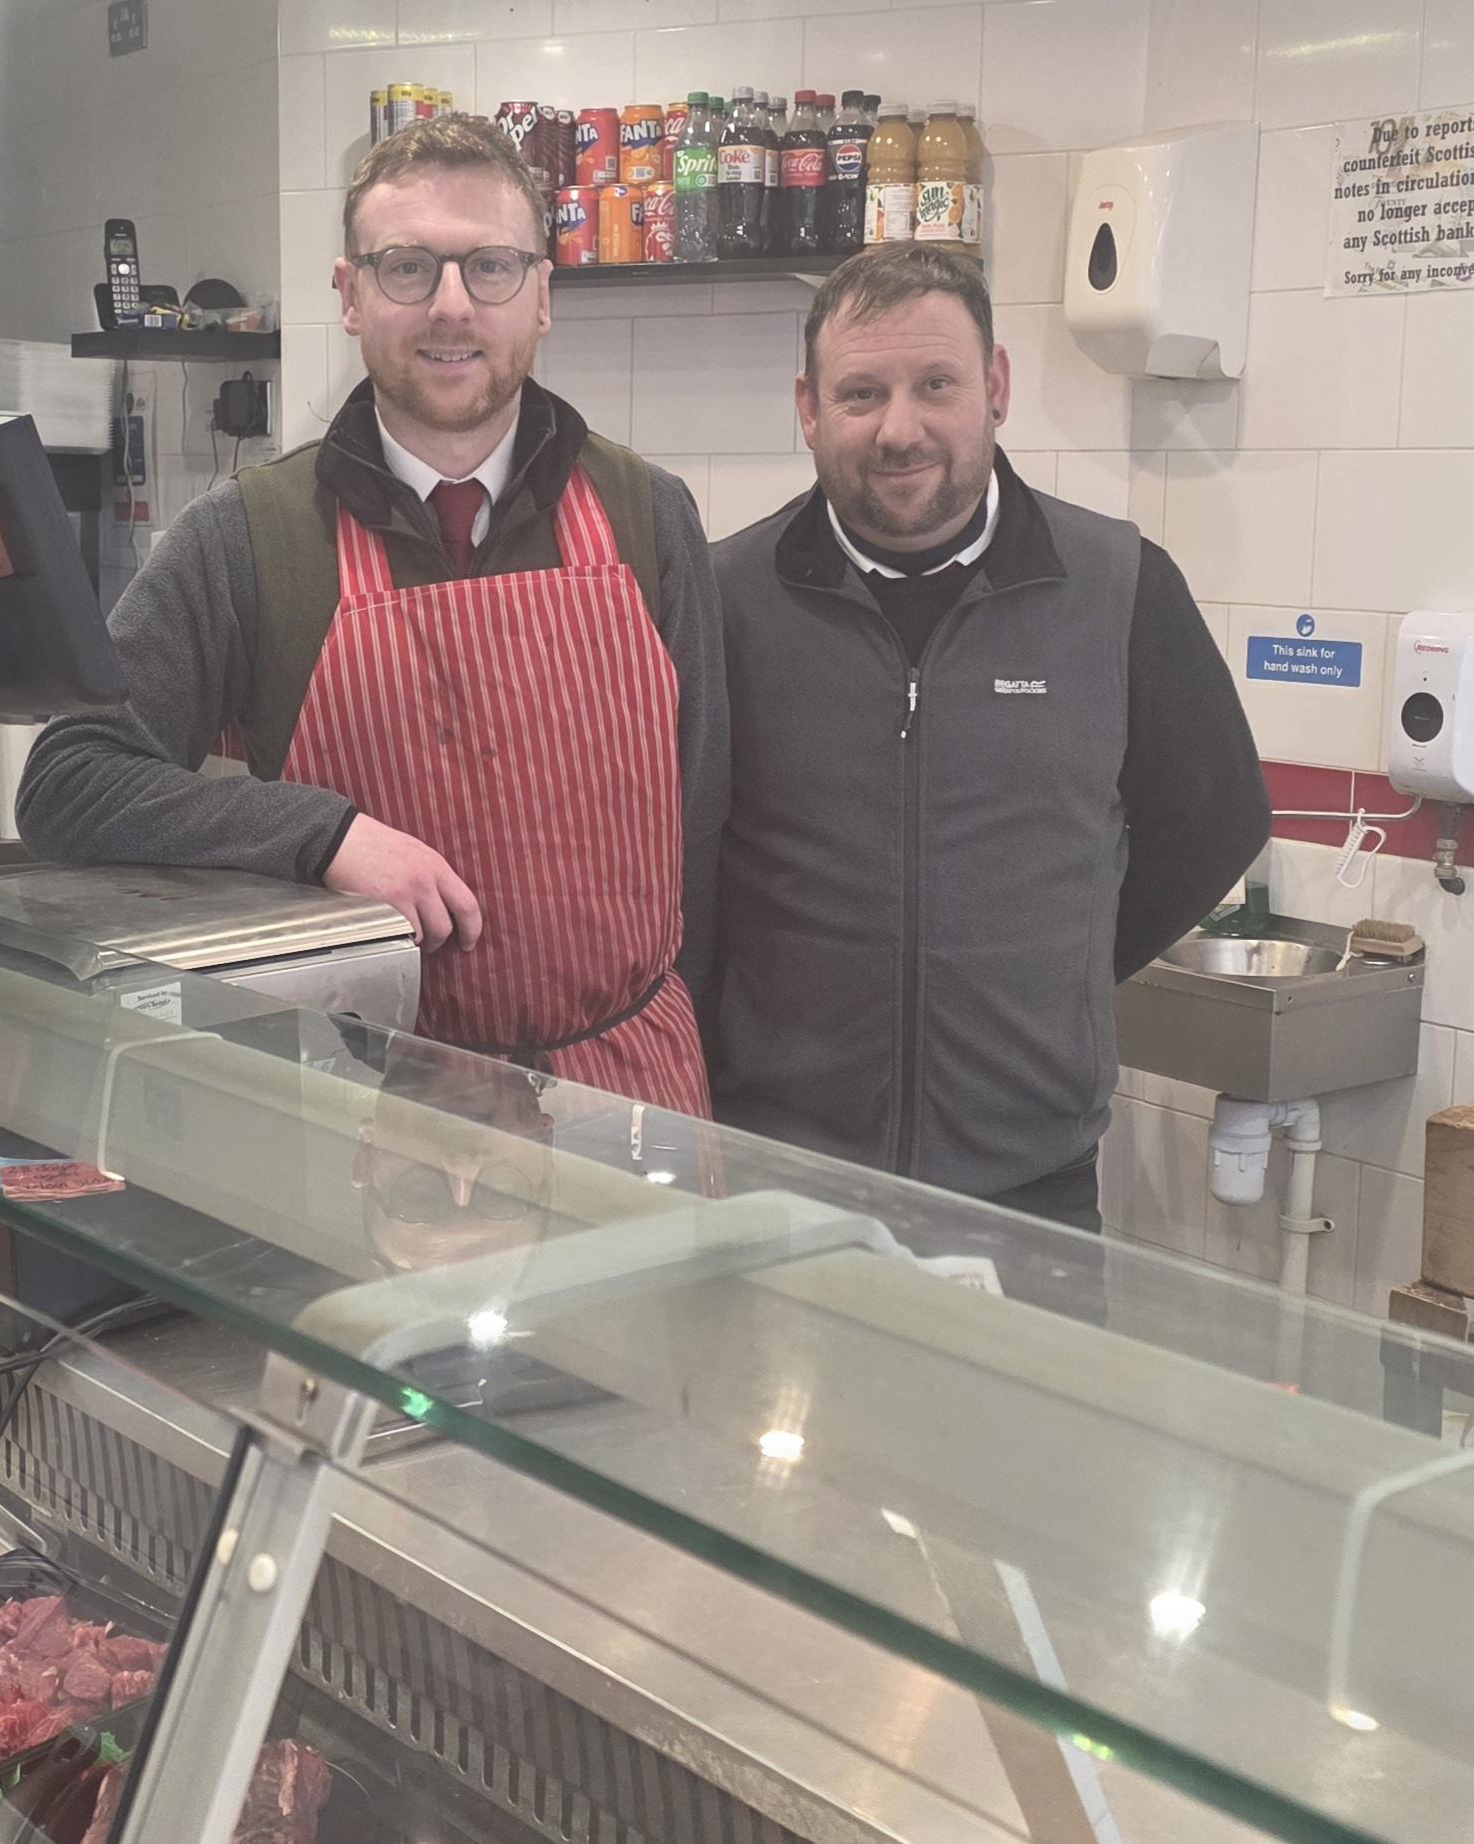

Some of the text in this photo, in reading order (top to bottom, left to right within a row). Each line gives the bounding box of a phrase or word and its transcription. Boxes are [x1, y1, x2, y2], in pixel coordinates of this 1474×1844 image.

[576, 123, 599, 142] NTA
[620, 120, 663, 142] FANTA
[1373, 117, 1474, 144] Due to report
[677, 153, 718, 177] Sprit
[719, 149, 750, 165] Coke
[1343, 149, 1421, 173] counterfeit
[1334, 183, 1370, 199] notes
[1375, 178, 1390, 196] in
[557, 202, 586, 224] NTA
[1357, 209, 1374, 223] no
[1380, 203, 1428, 223] longer
[1343, 222, 1474, 252] any Scottish bank
[1344, 271, 1374, 286] Sorry
[1379, 268, 1395, 282] for
[1401, 268, 1422, 283] any
[1273, 644, 1335, 660] This sink for
[1264, 660, 1343, 679] hand wash only
